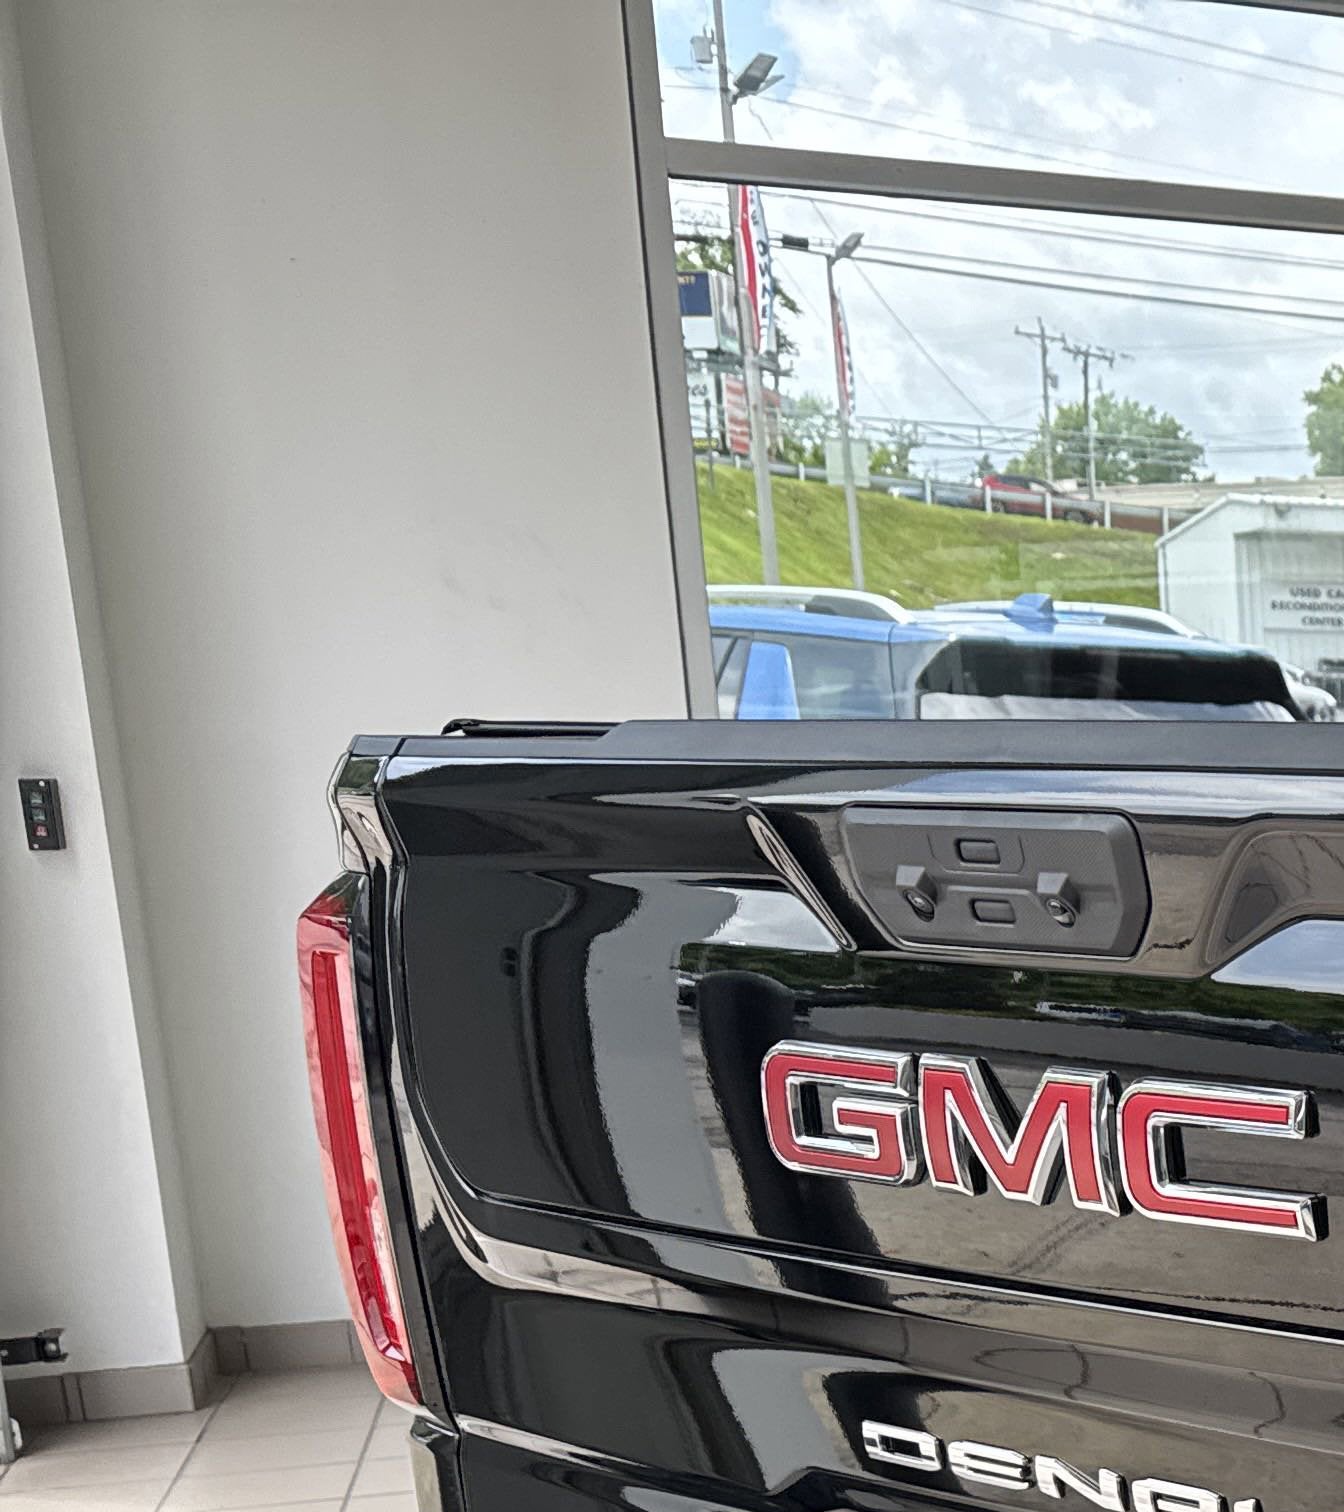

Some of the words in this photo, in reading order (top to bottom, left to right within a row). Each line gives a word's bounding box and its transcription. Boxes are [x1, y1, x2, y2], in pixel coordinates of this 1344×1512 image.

[1289, 587, 1322, 599] USED
[1301, 615, 1344, 627] CENTER
[761, 1039, 1330, 1242] GMC
